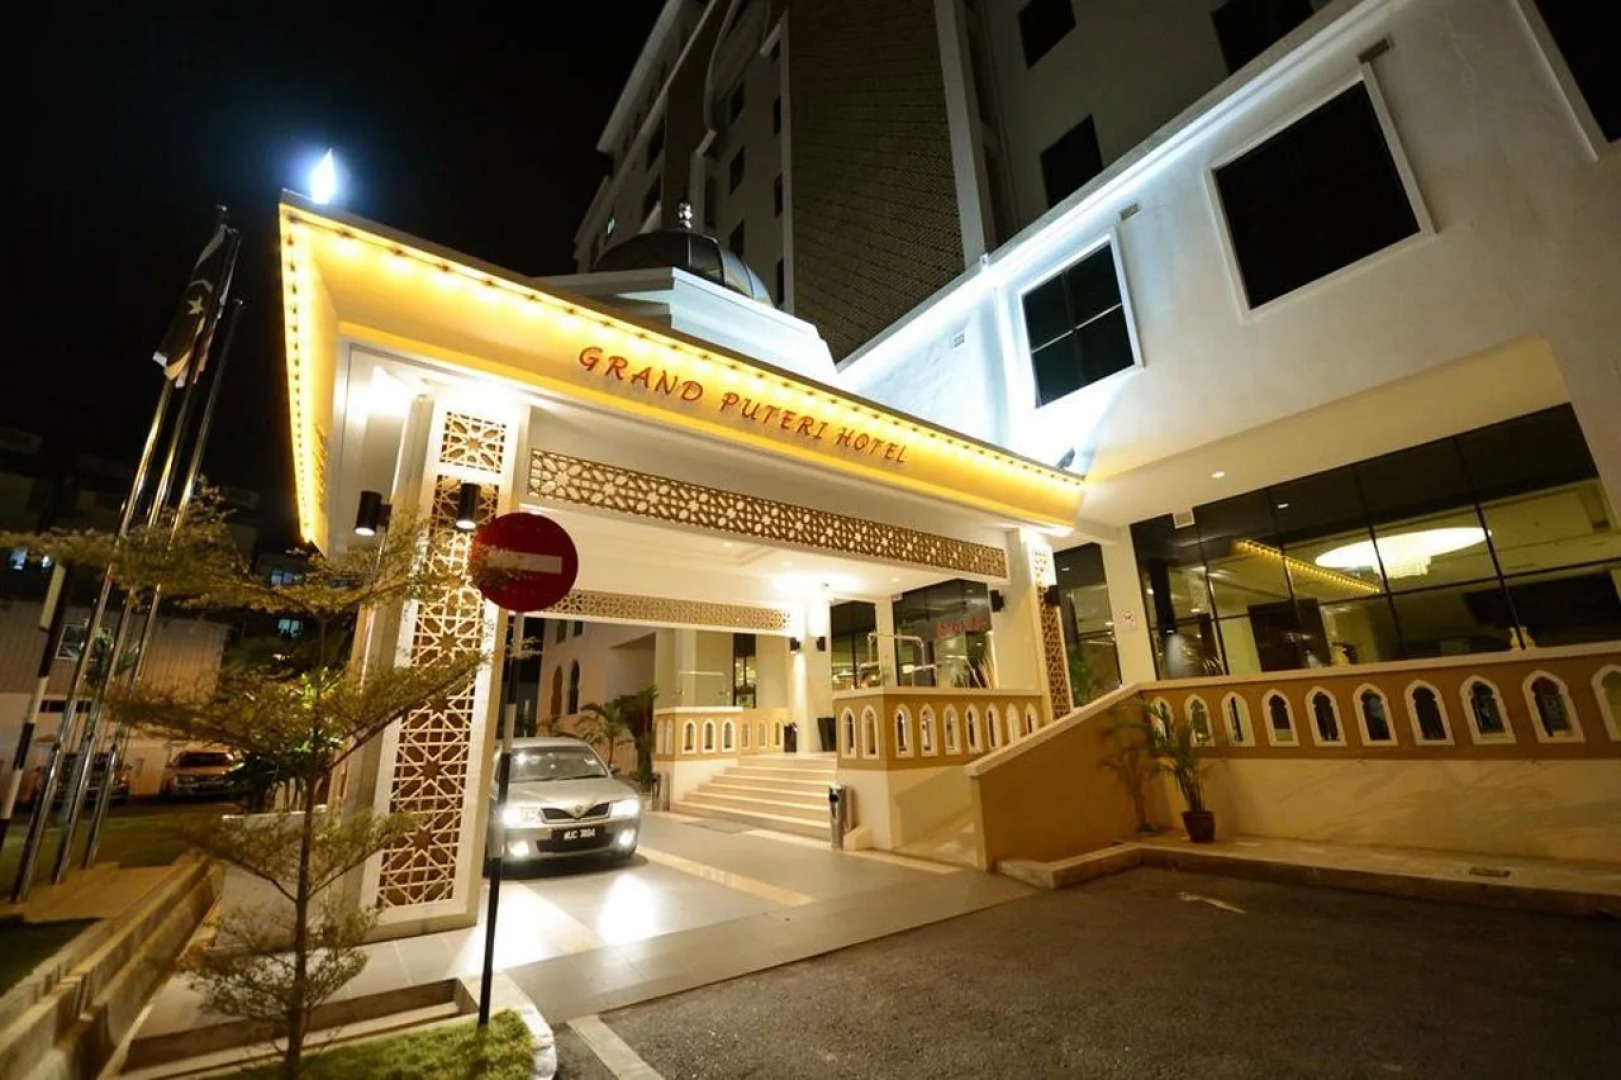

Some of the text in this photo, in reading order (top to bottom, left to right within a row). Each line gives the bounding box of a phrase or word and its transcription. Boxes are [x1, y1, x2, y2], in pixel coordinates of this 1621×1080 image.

[579, 346, 908, 464] GRAND PUTERI HOTEL
